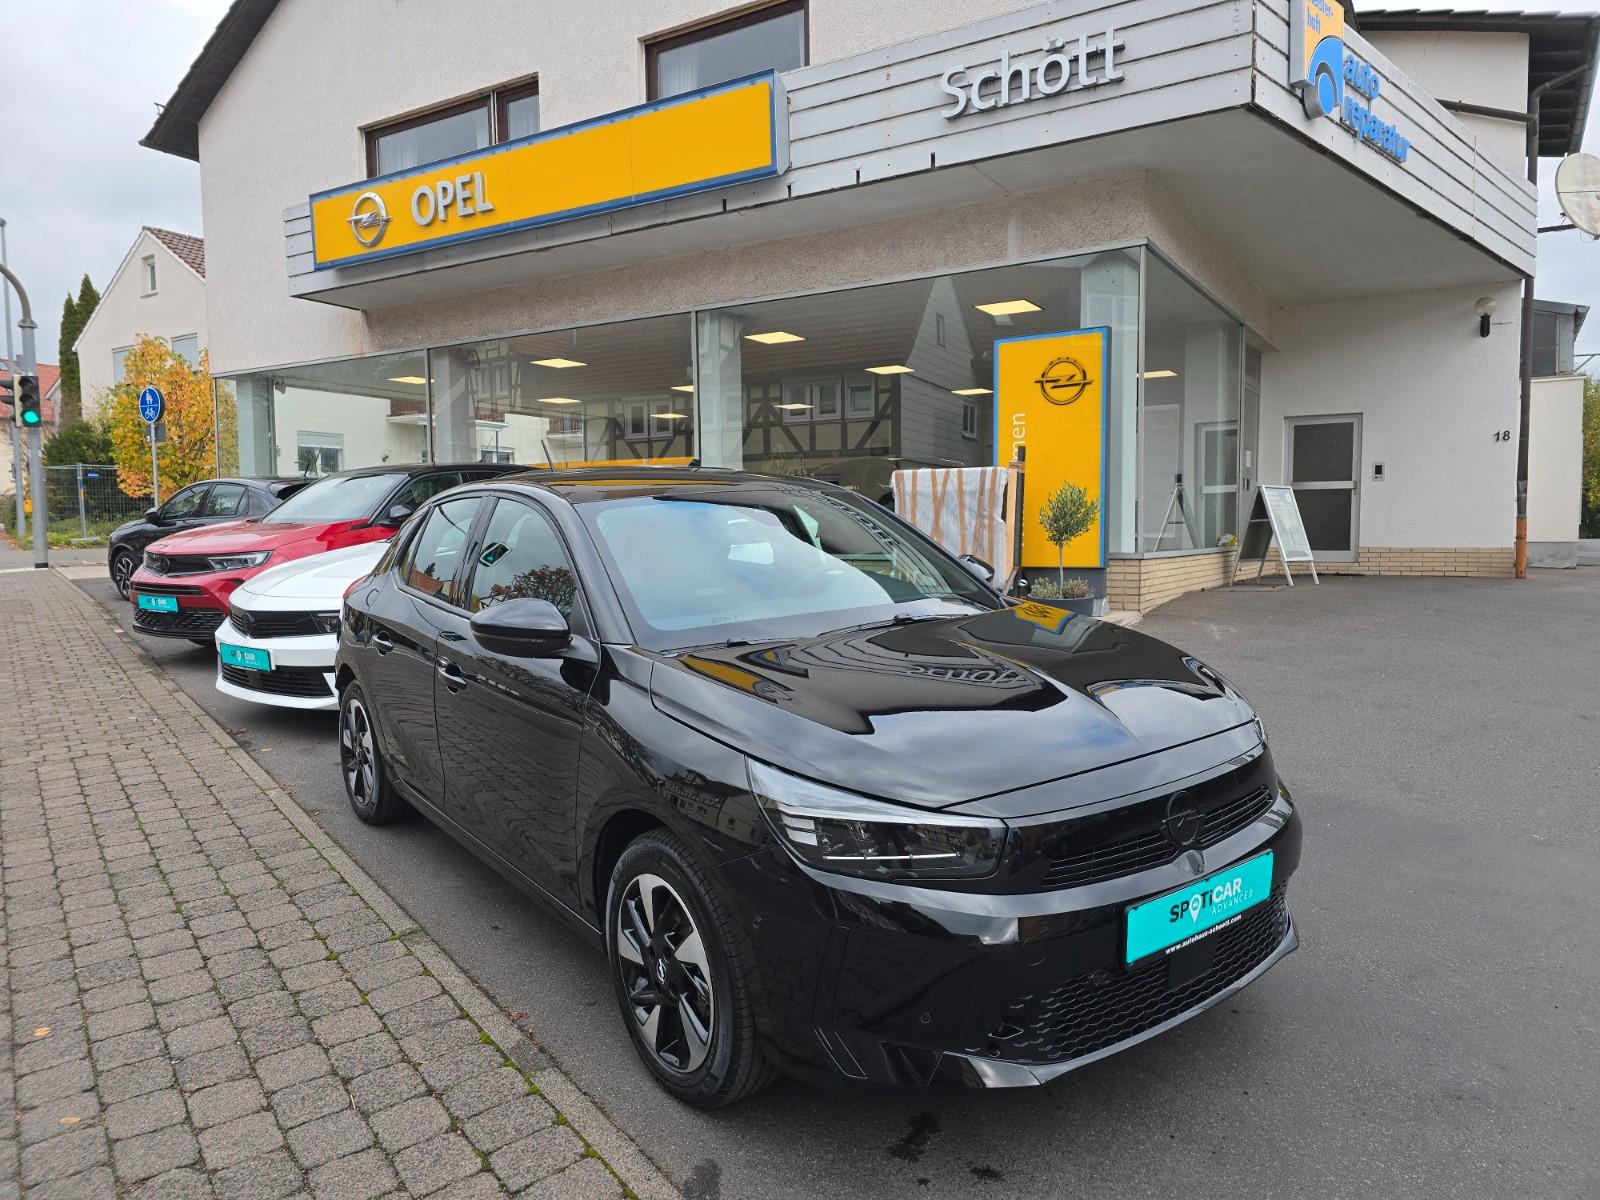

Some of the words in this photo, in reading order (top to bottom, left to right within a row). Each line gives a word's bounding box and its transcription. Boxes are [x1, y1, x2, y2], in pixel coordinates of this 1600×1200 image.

[940, 26, 1126, 120] Schött
[1344, 54, 1379, 100] auto
[1343, 95, 1409, 162] reparatur
[411, 171, 494, 226] OPEL
[1494, 430, 1510, 441] 18
[1211, 889, 1254, 916] ADVANCED
